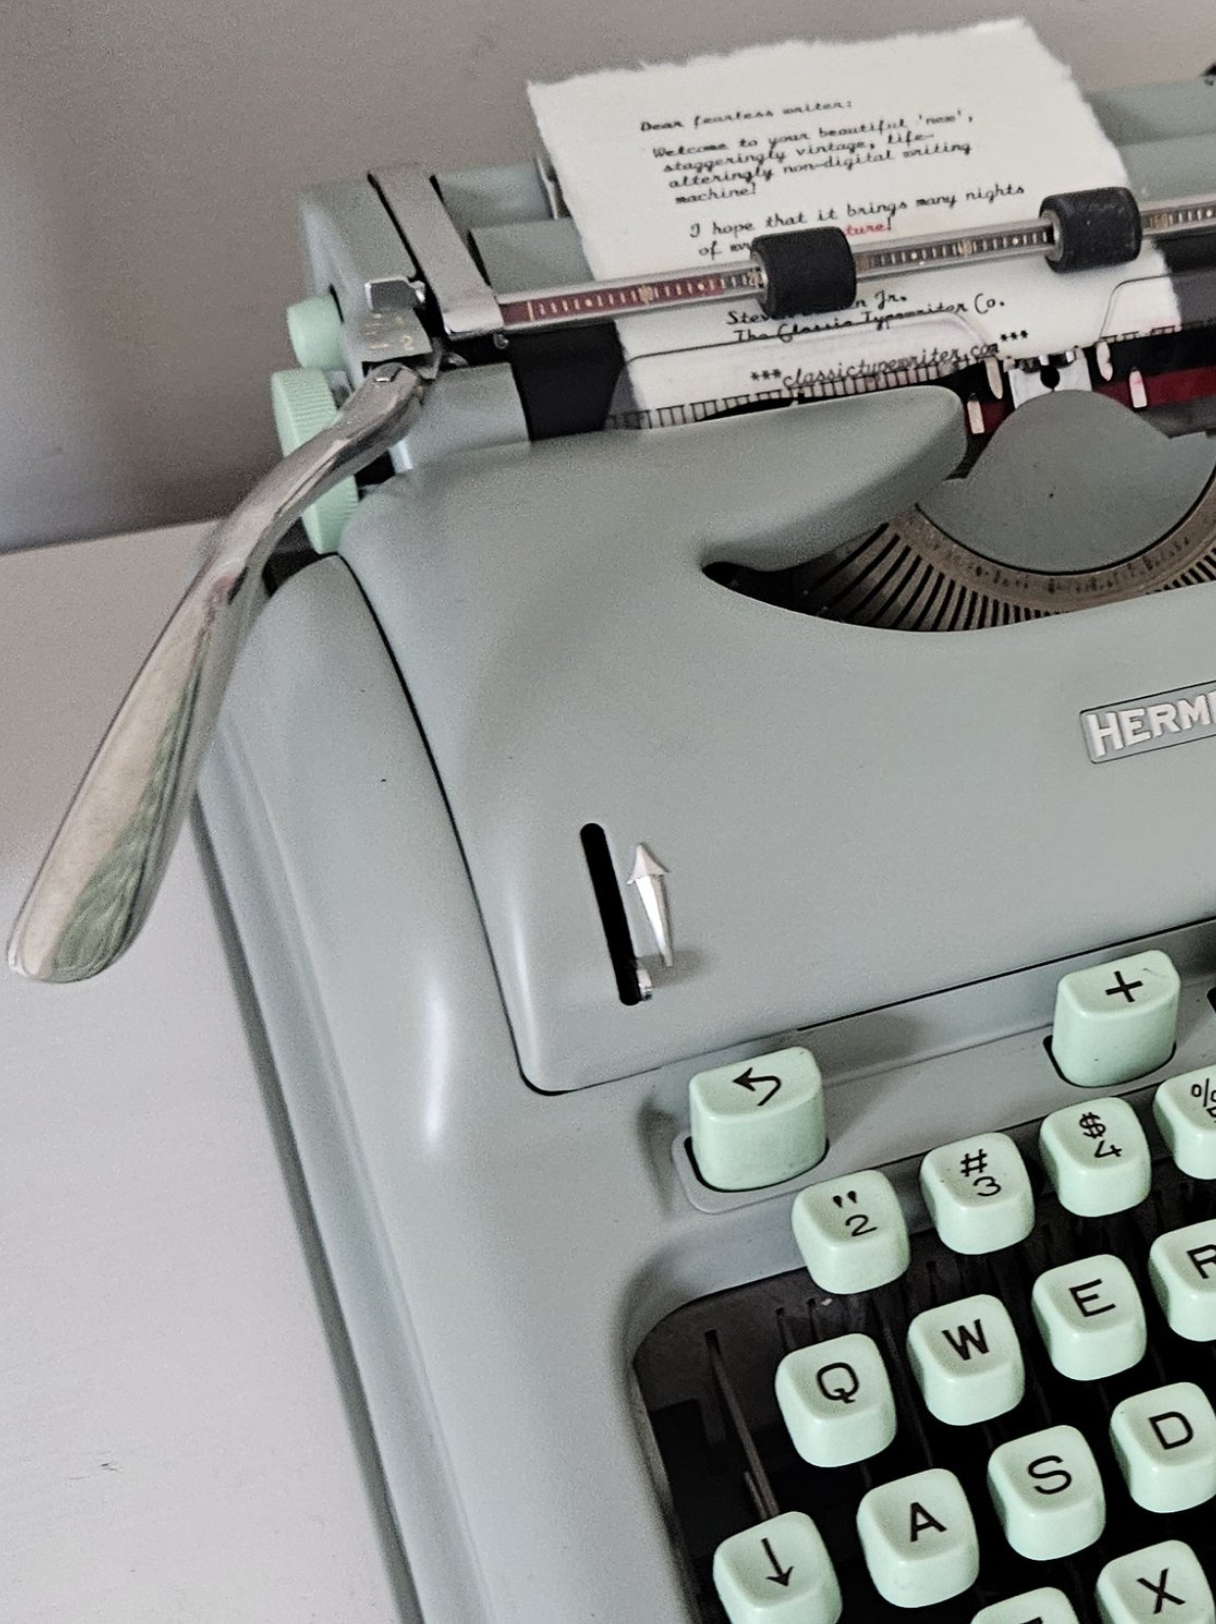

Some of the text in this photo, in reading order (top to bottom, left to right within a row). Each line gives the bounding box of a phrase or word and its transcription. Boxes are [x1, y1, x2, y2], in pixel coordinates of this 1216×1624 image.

[639, 100, 852, 132] Dear fearless writer:
[652, 142, 728, 158] Welcome
[739, 138, 758, 147] to
[768, 132, 810, 151] your
[818, 118, 907, 137] beautiful
[663, 149, 786, 173] staggeringly
[795, 140, 875, 156] vintage,
[669, 142, 972, 188] alteringly non-digital writing
[675, 181, 756, 205] machine!
[689, 183, 1025, 238] I hope that it brings many nights
[698, 240, 723, 260] of
[733, 328, 771, 342] The
[974, 292, 1005, 315] Co.
[874, 289, 907, 310] Jr.
[1078, 1111, 1107, 1140] $
[959, 1148, 989, 1179] #
[1093, 1139, 1123, 1159] 4
[972, 1175, 1002, 1198] 3
[844, 1213, 878, 1238] 2
[1068, 1278, 1117, 1318] E
[940, 1318, 990, 1362] W
[815, 1361, 860, 1405] Q
[1147, 1411, 1194, 1451] D
[1026, 1454, 1073, 1496] S
[909, 1501, 948, 1544] A
[1135, 1568, 1186, 1615] X
